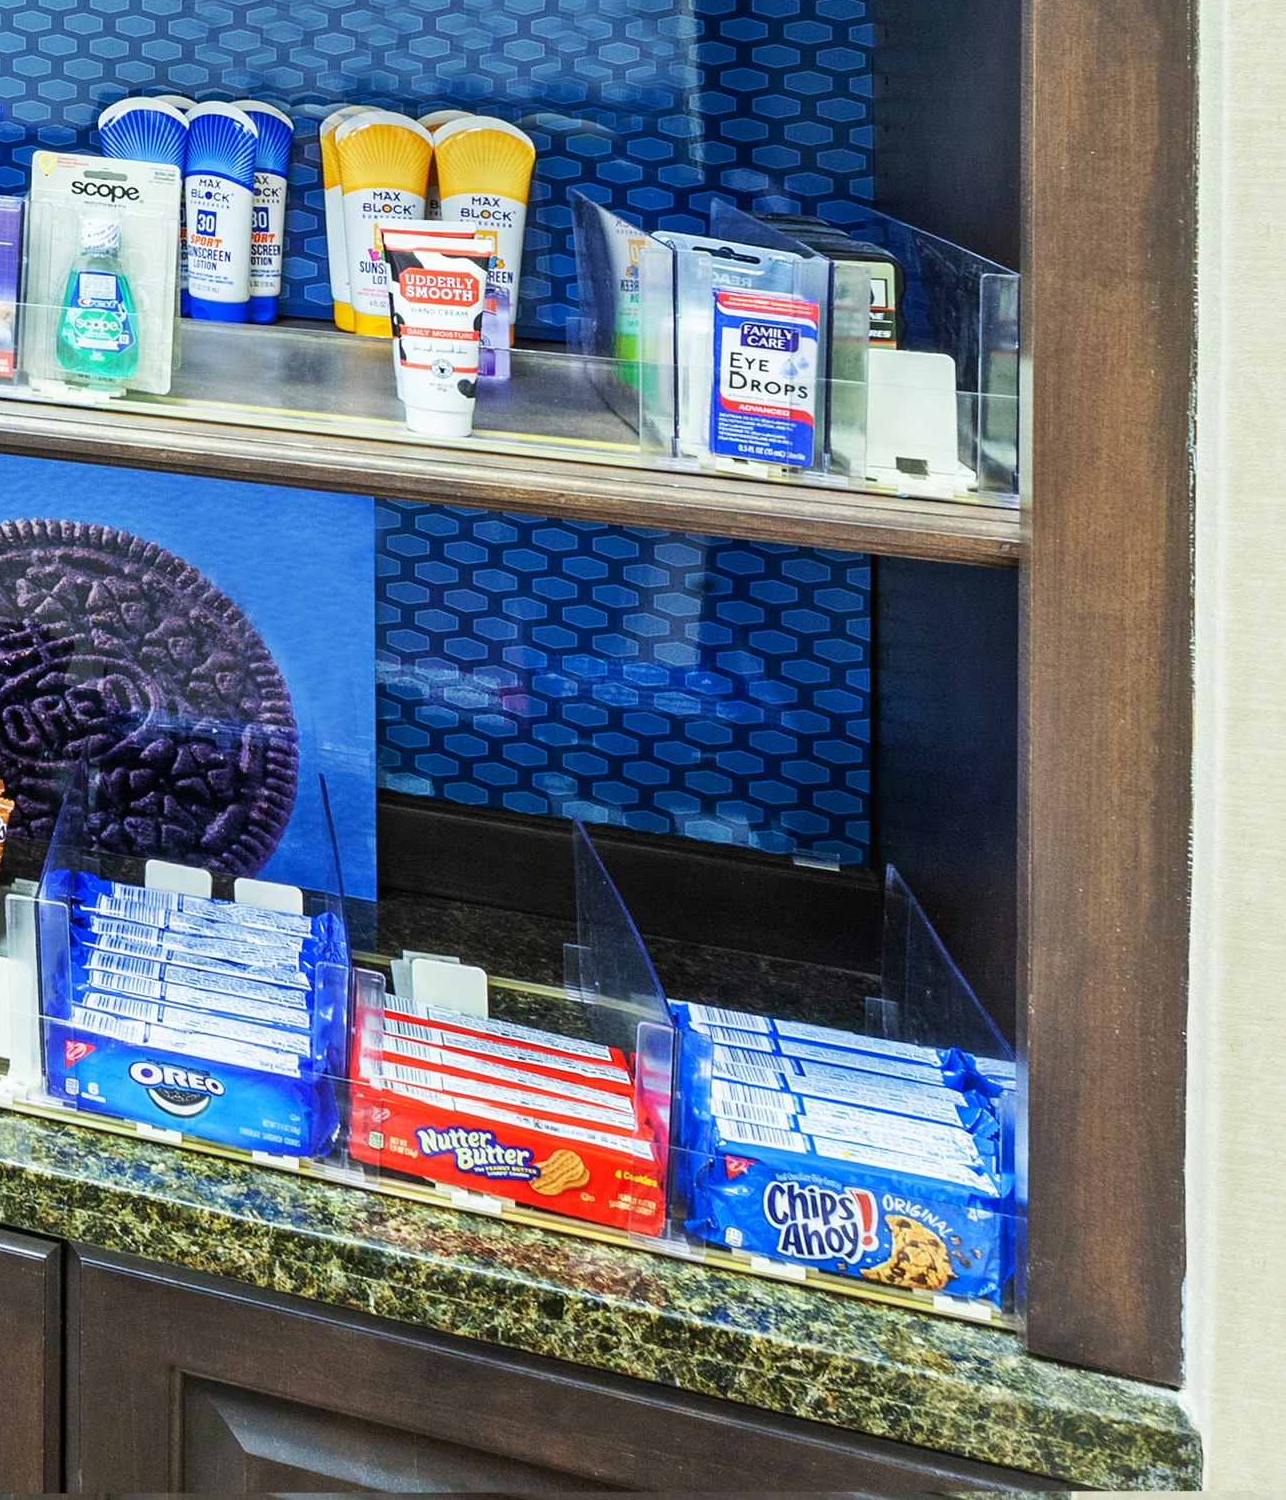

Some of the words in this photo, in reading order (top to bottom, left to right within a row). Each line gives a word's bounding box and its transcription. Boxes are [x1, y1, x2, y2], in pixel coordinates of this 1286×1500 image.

[71, 180, 141, 203] scope
[199, 178, 222, 190] MAX
[190, 188, 231, 203] BLOCK
[372, 191, 401, 202] MAX
[471, 196, 501, 207] MAX
[362, 203, 413, 216] BLOCK
[460, 207, 513, 222] BLOCK
[197, 213, 216, 233] 30
[190, 234, 223, 248] SPORT
[193, 258, 217, 271] LOTION
[251, 257, 273, 266] OTION
[405, 273, 475, 288] UDDERLY
[406, 285, 475, 302] SMOOTH
[410, 307, 436, 316] HAND
[438, 309, 470, 318] CREAM
[75, 316, 120, 333] scope
[743, 324, 793, 340] FAMILY
[406, 327, 434, 337] DAILY
[435, 330, 475, 340] MOISTURE
[747, 336, 787, 350] CARE
[729, 351, 770, 373] EYE
[729, 370, 809, 400] DROPS
[738, 403, 790, 417] ADVANCED
[128, 1060, 225, 1097] OREO
[87, 1081, 100, 1096] 6
[417, 1128, 494, 1156] Nutter
[455, 1147, 531, 1170] Butter
[614, 1169, 622, 1179] 4
[623, 1171, 659, 1187] Cookies
[767, 1183, 855, 1227] Chips
[881, 1194, 953, 1240] ORIGINAL
